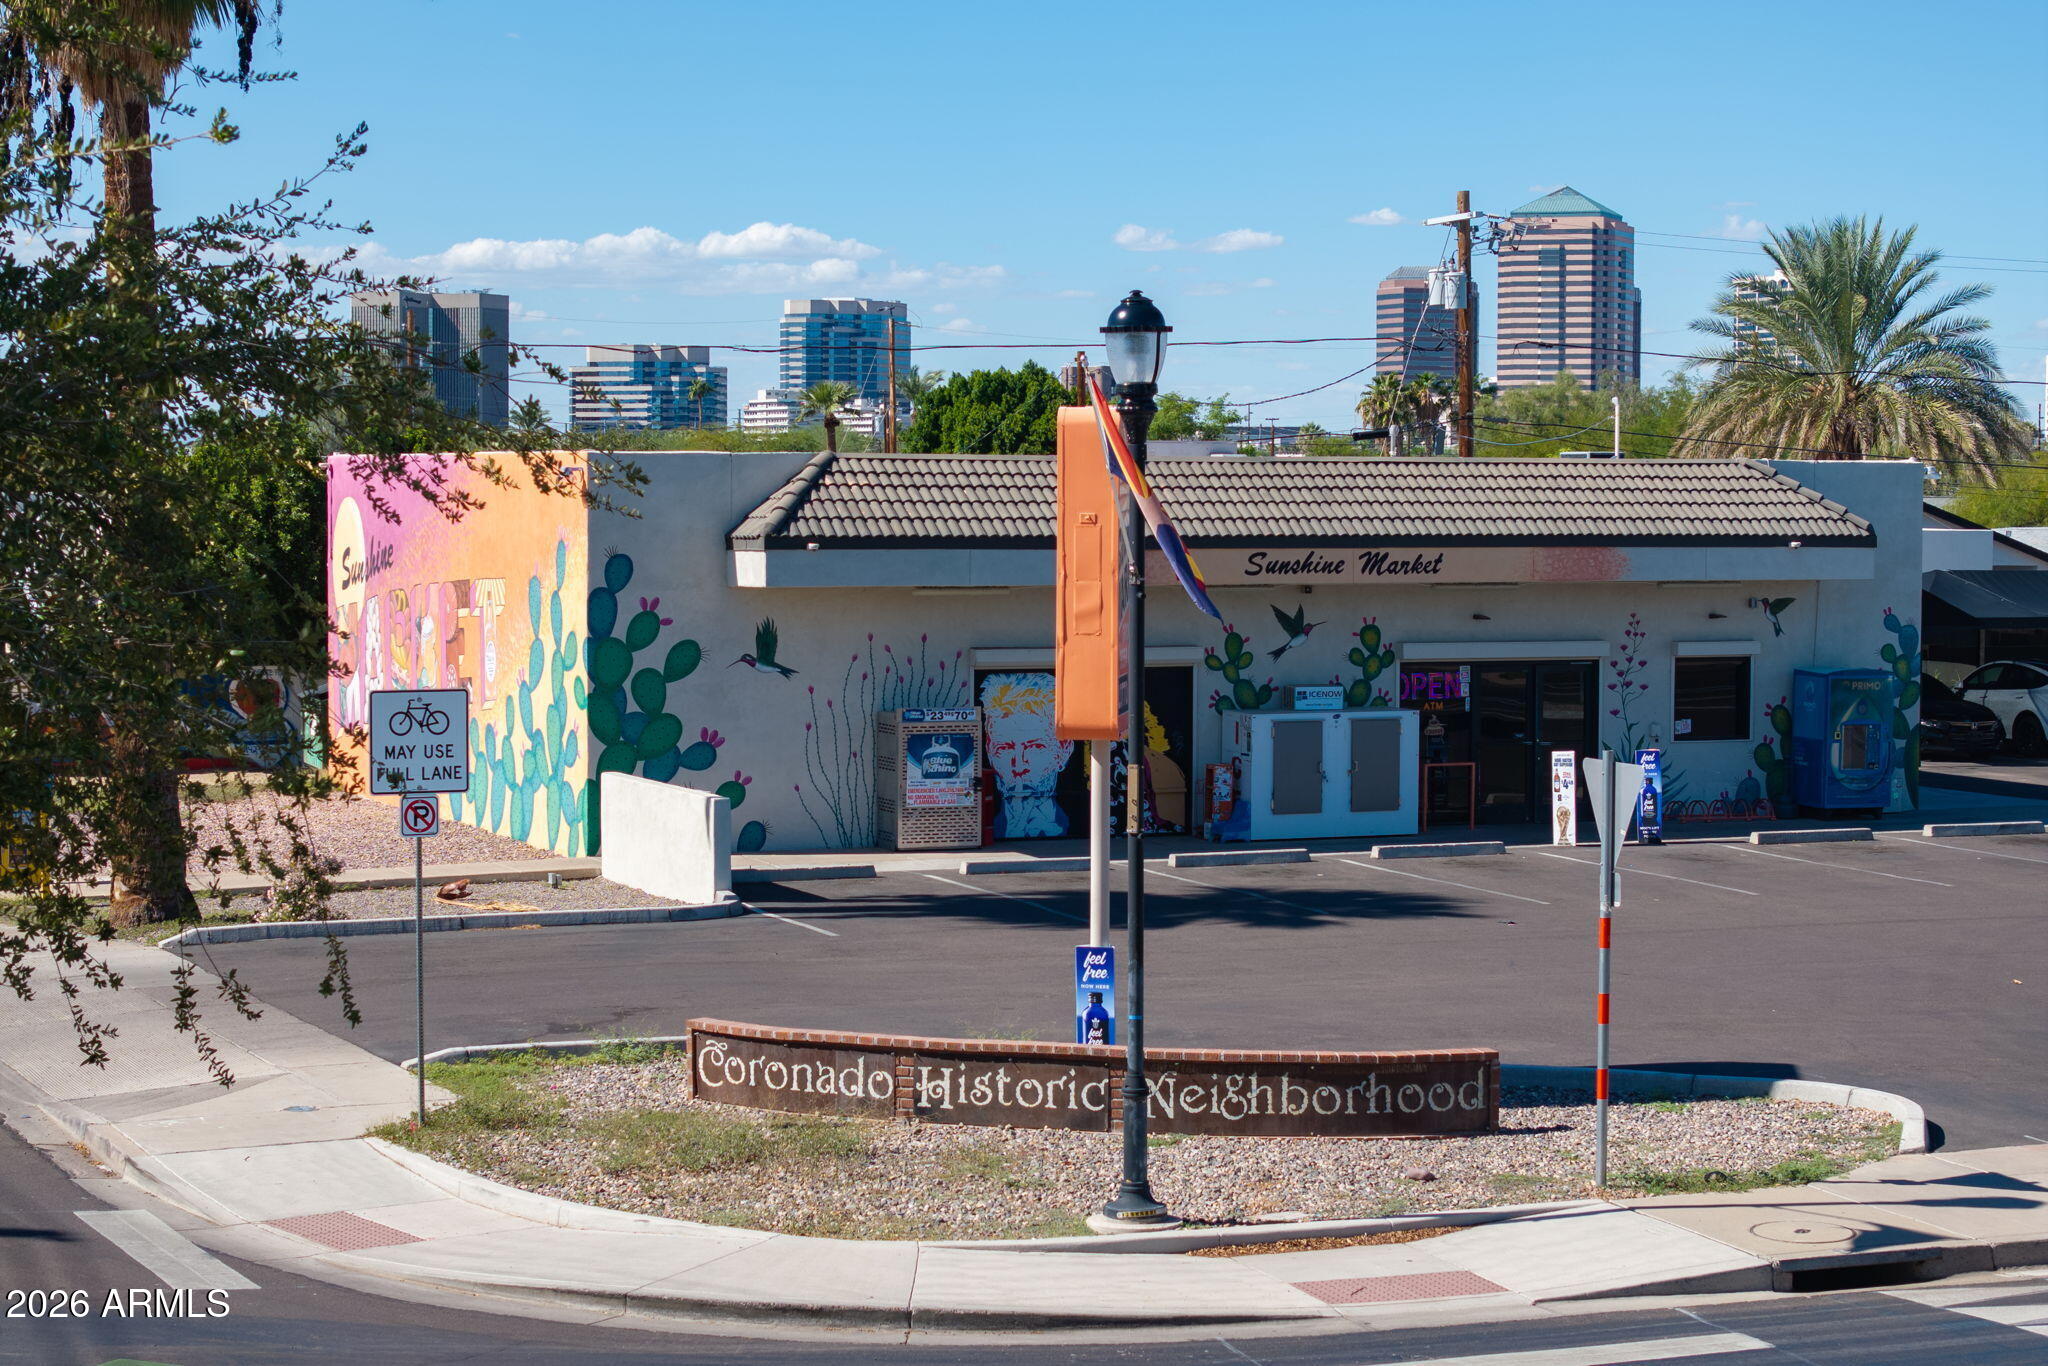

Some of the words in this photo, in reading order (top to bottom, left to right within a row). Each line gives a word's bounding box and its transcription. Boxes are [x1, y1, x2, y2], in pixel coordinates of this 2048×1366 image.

[342, 536, 394, 590] Sunshine
[1244, 550, 1345, 577] Sunshine
[1358, 551, 1445, 577] Market
[1851, 681, 1882, 690] PRIMO
[1308, 690, 1343, 698] ICENOW
[1423, 701, 1444, 711] ATM
[384, 744, 417, 760] MAY
[423, 743, 455, 759] USE
[1640, 752, 1656, 763] feel
[421, 765, 463, 781] LANE
[1083, 951, 1107, 968] feel
[1082, 965, 1108, 982] free
[1087, 1028, 1103, 1039] feel
[698, 1039, 895, 1100] Coronado
[915, 1062, 1110, 1112] Historic
[1144, 1066, 1486, 1121] Neighborhood
